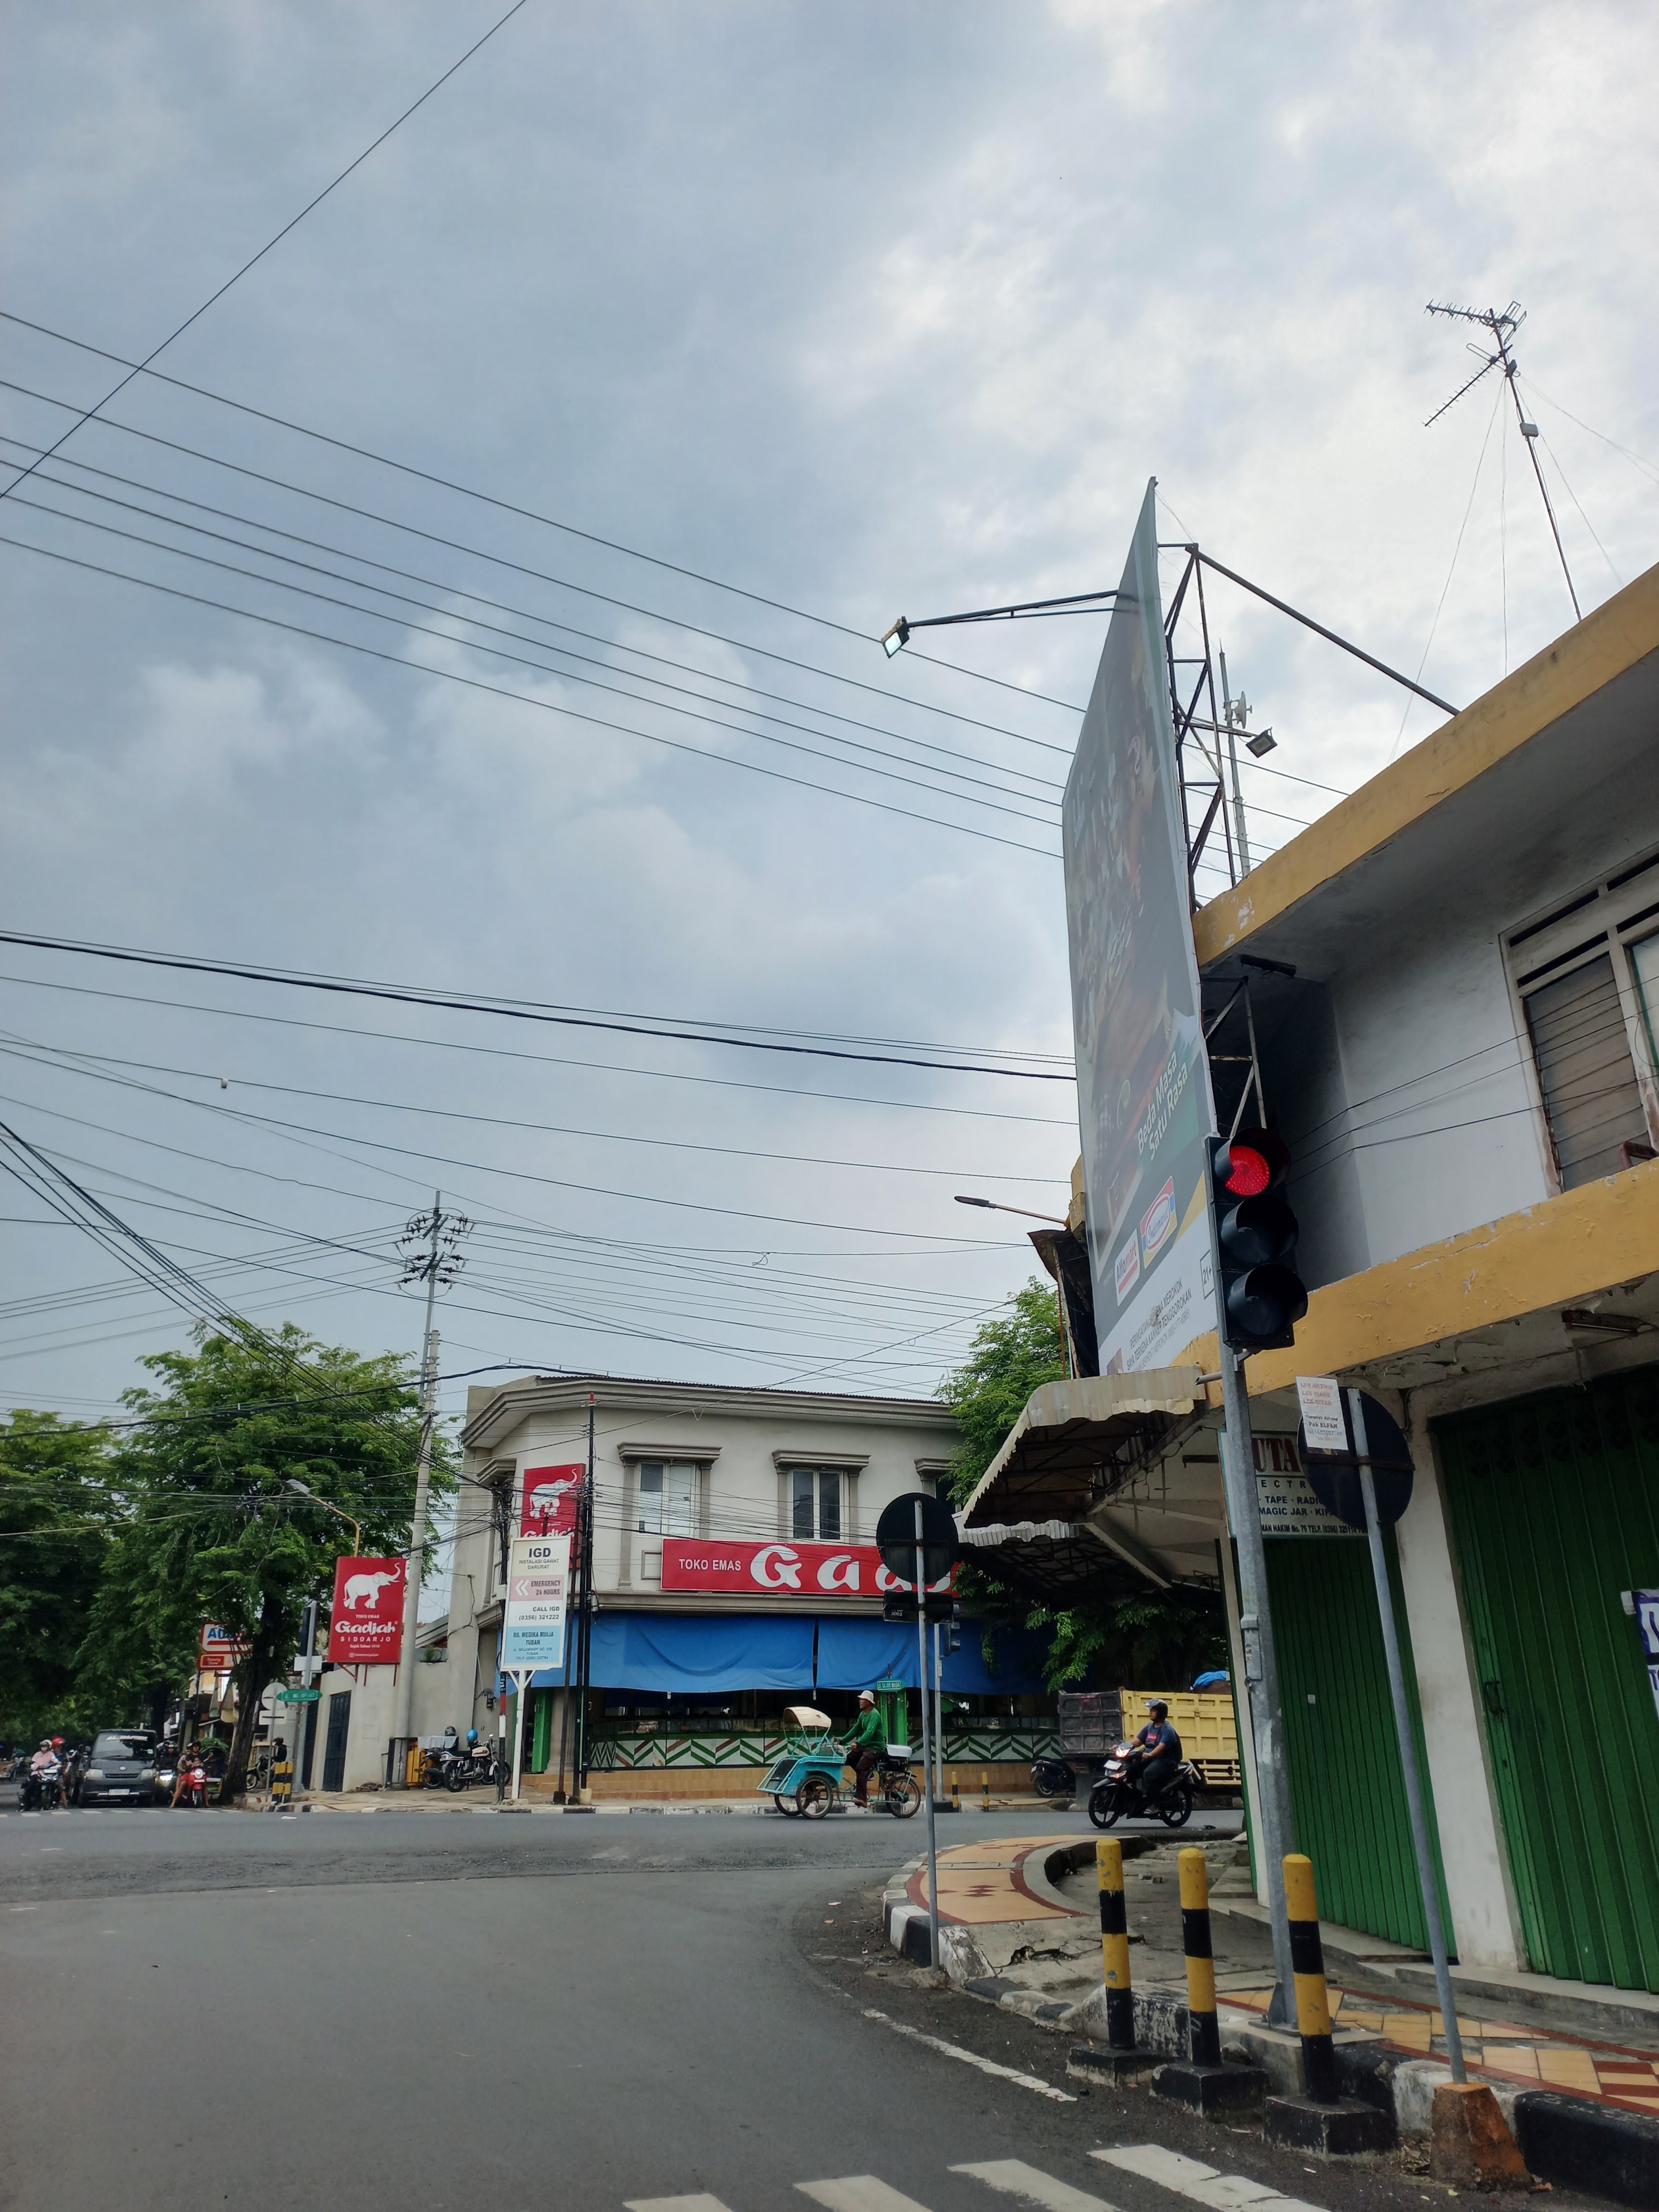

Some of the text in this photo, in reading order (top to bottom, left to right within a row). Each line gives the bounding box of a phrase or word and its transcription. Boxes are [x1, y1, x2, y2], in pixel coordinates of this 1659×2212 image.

[1138, 1051, 1177, 1156] Beda Masa
[1150, 1062, 1188, 1161] Satu Rasa
[1117, 1240, 1137, 1283] Alfamart
[1162, 1287, 1192, 1327] TENGGOROKAN
[1259, 1507, 1288, 1515] MAGIC
[1273, 1524, 1291, 1532] HAKIM
[529, 1548, 551, 1558] IGD
[679, 1559, 709, 1571] TOKO
[712, 1559, 741, 1571] EMAS
[335, 1620, 396, 1636] Gadjah
